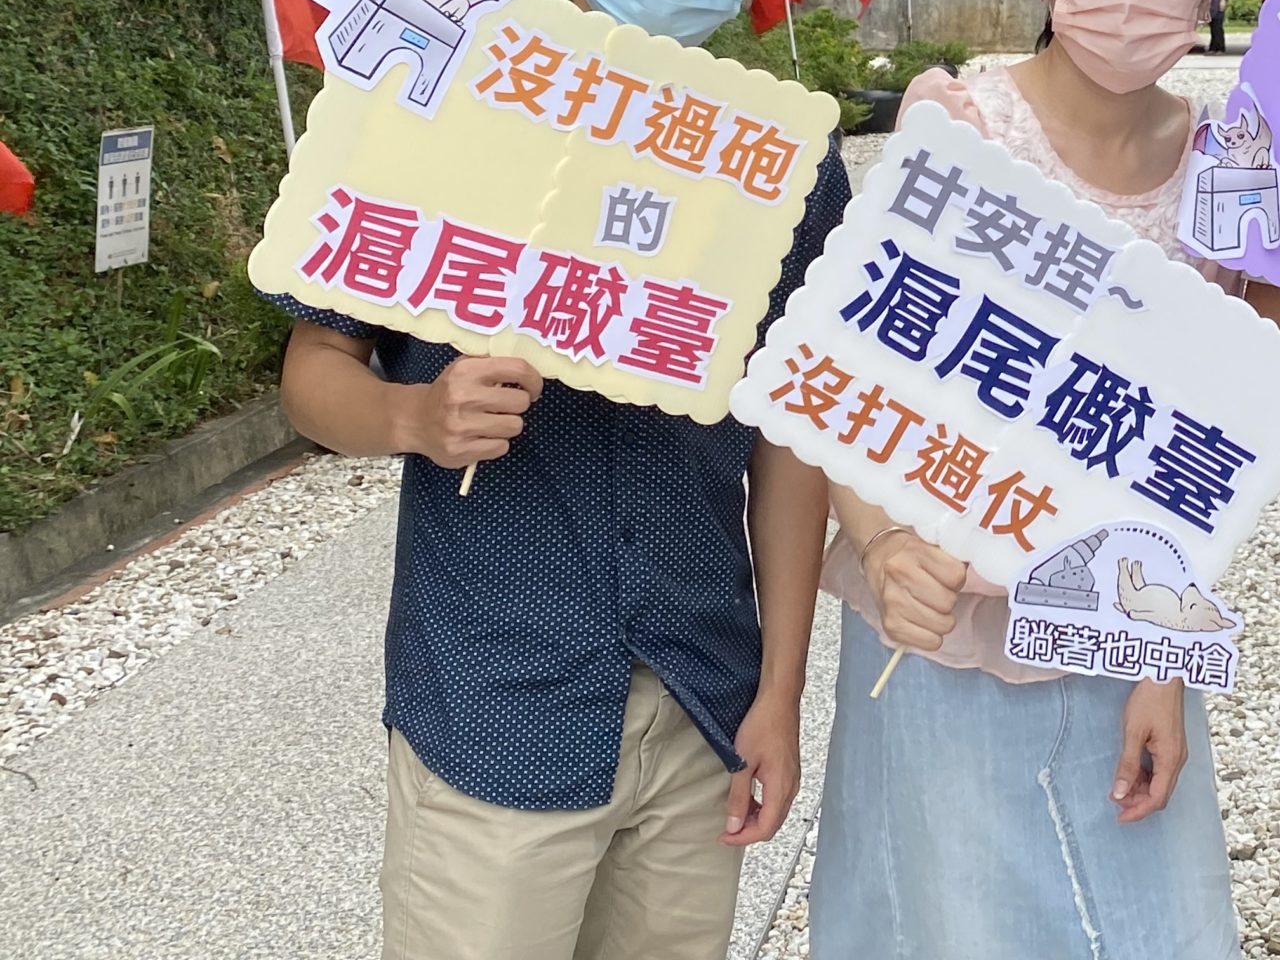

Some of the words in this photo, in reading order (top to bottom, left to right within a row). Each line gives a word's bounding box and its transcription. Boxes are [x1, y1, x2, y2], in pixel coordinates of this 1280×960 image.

[475, 26, 796, 201] 沒打過砲
[301, 188, 728, 385] 滬尾礮臺
[602, 187, 673, 252] 的
[769, 344, 1058, 552] 沒打過仗
[838, 238, 1257, 534] 滬尾礮臺
[1010, 617, 1233, 688] 躺著也中槍
